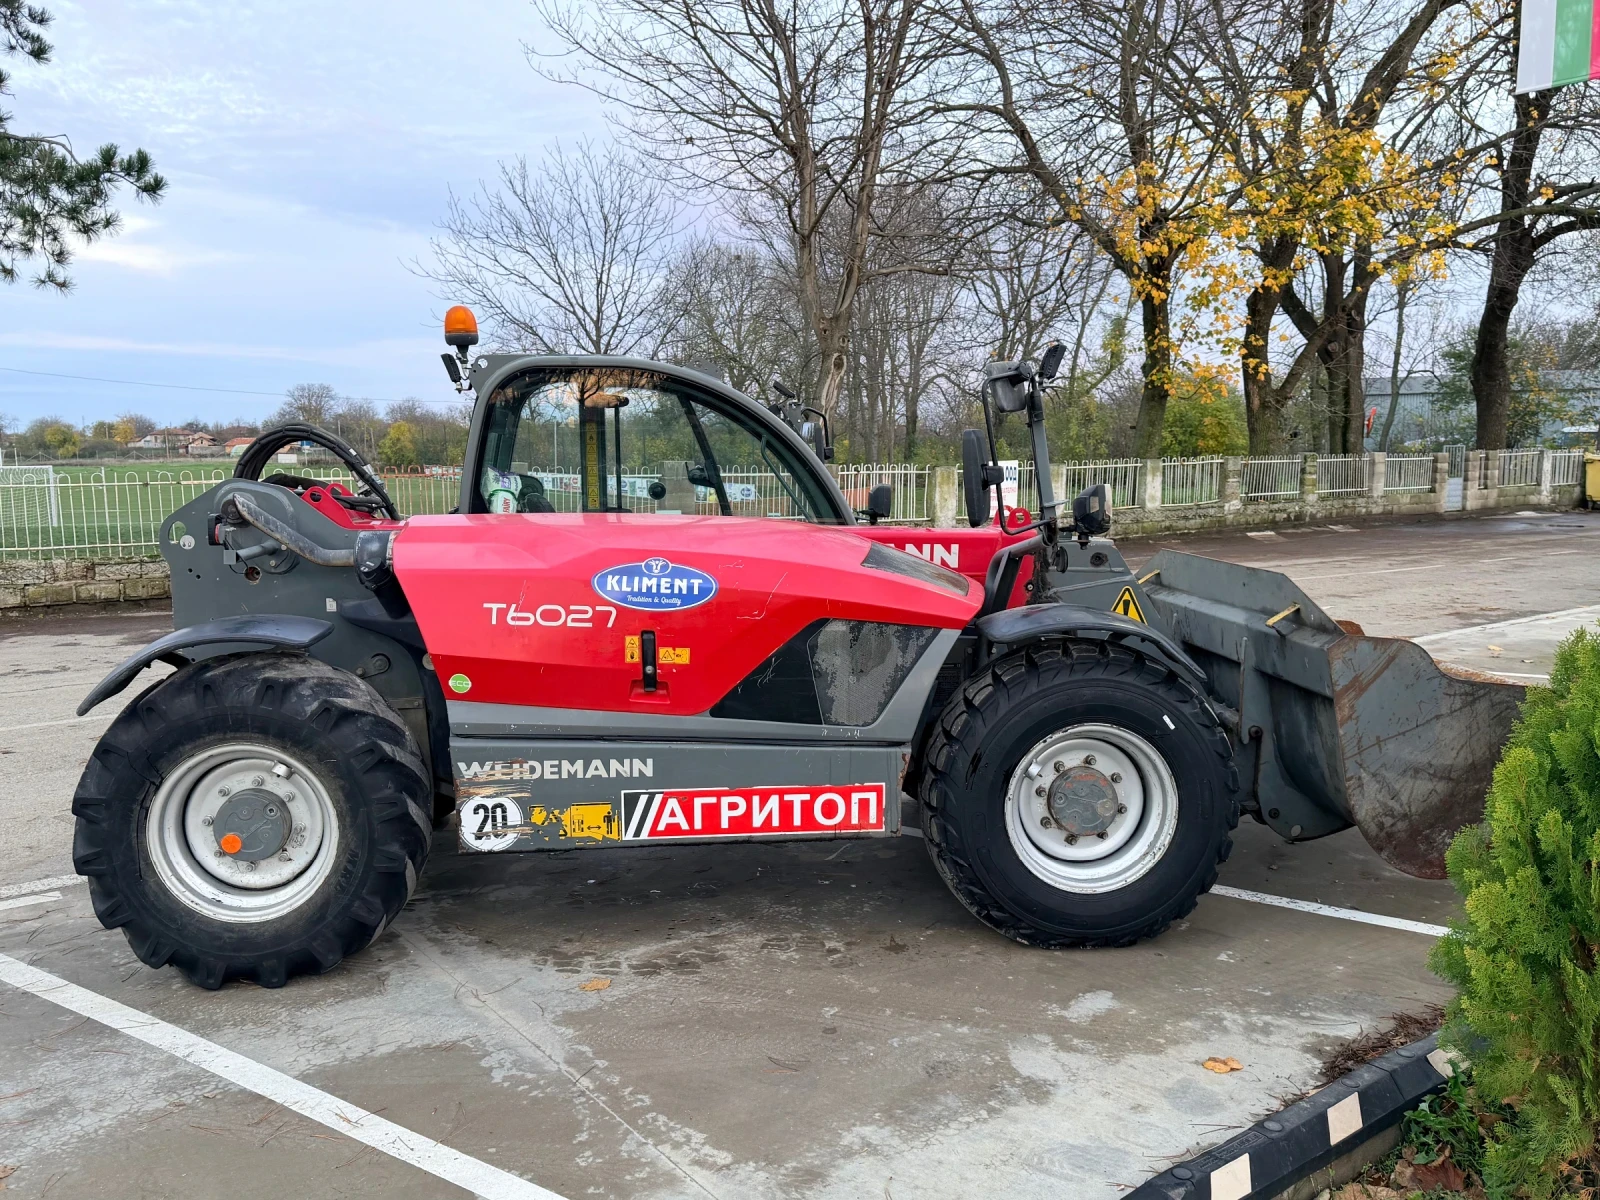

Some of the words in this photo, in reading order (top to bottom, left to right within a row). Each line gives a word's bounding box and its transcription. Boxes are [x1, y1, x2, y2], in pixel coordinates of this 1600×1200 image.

[606, 575, 703, 595] KLIMENT
[627, 595, 652, 603] Tradition
[661, 597, 682, 606] Quality
[483, 603, 617, 628] T6027
[449, 680, 472, 688] ECO
[457, 758, 654, 780] WEIDEMANN
[472, 803, 508, 841] 20
[656, 792, 878, 831] АГРИТОП
